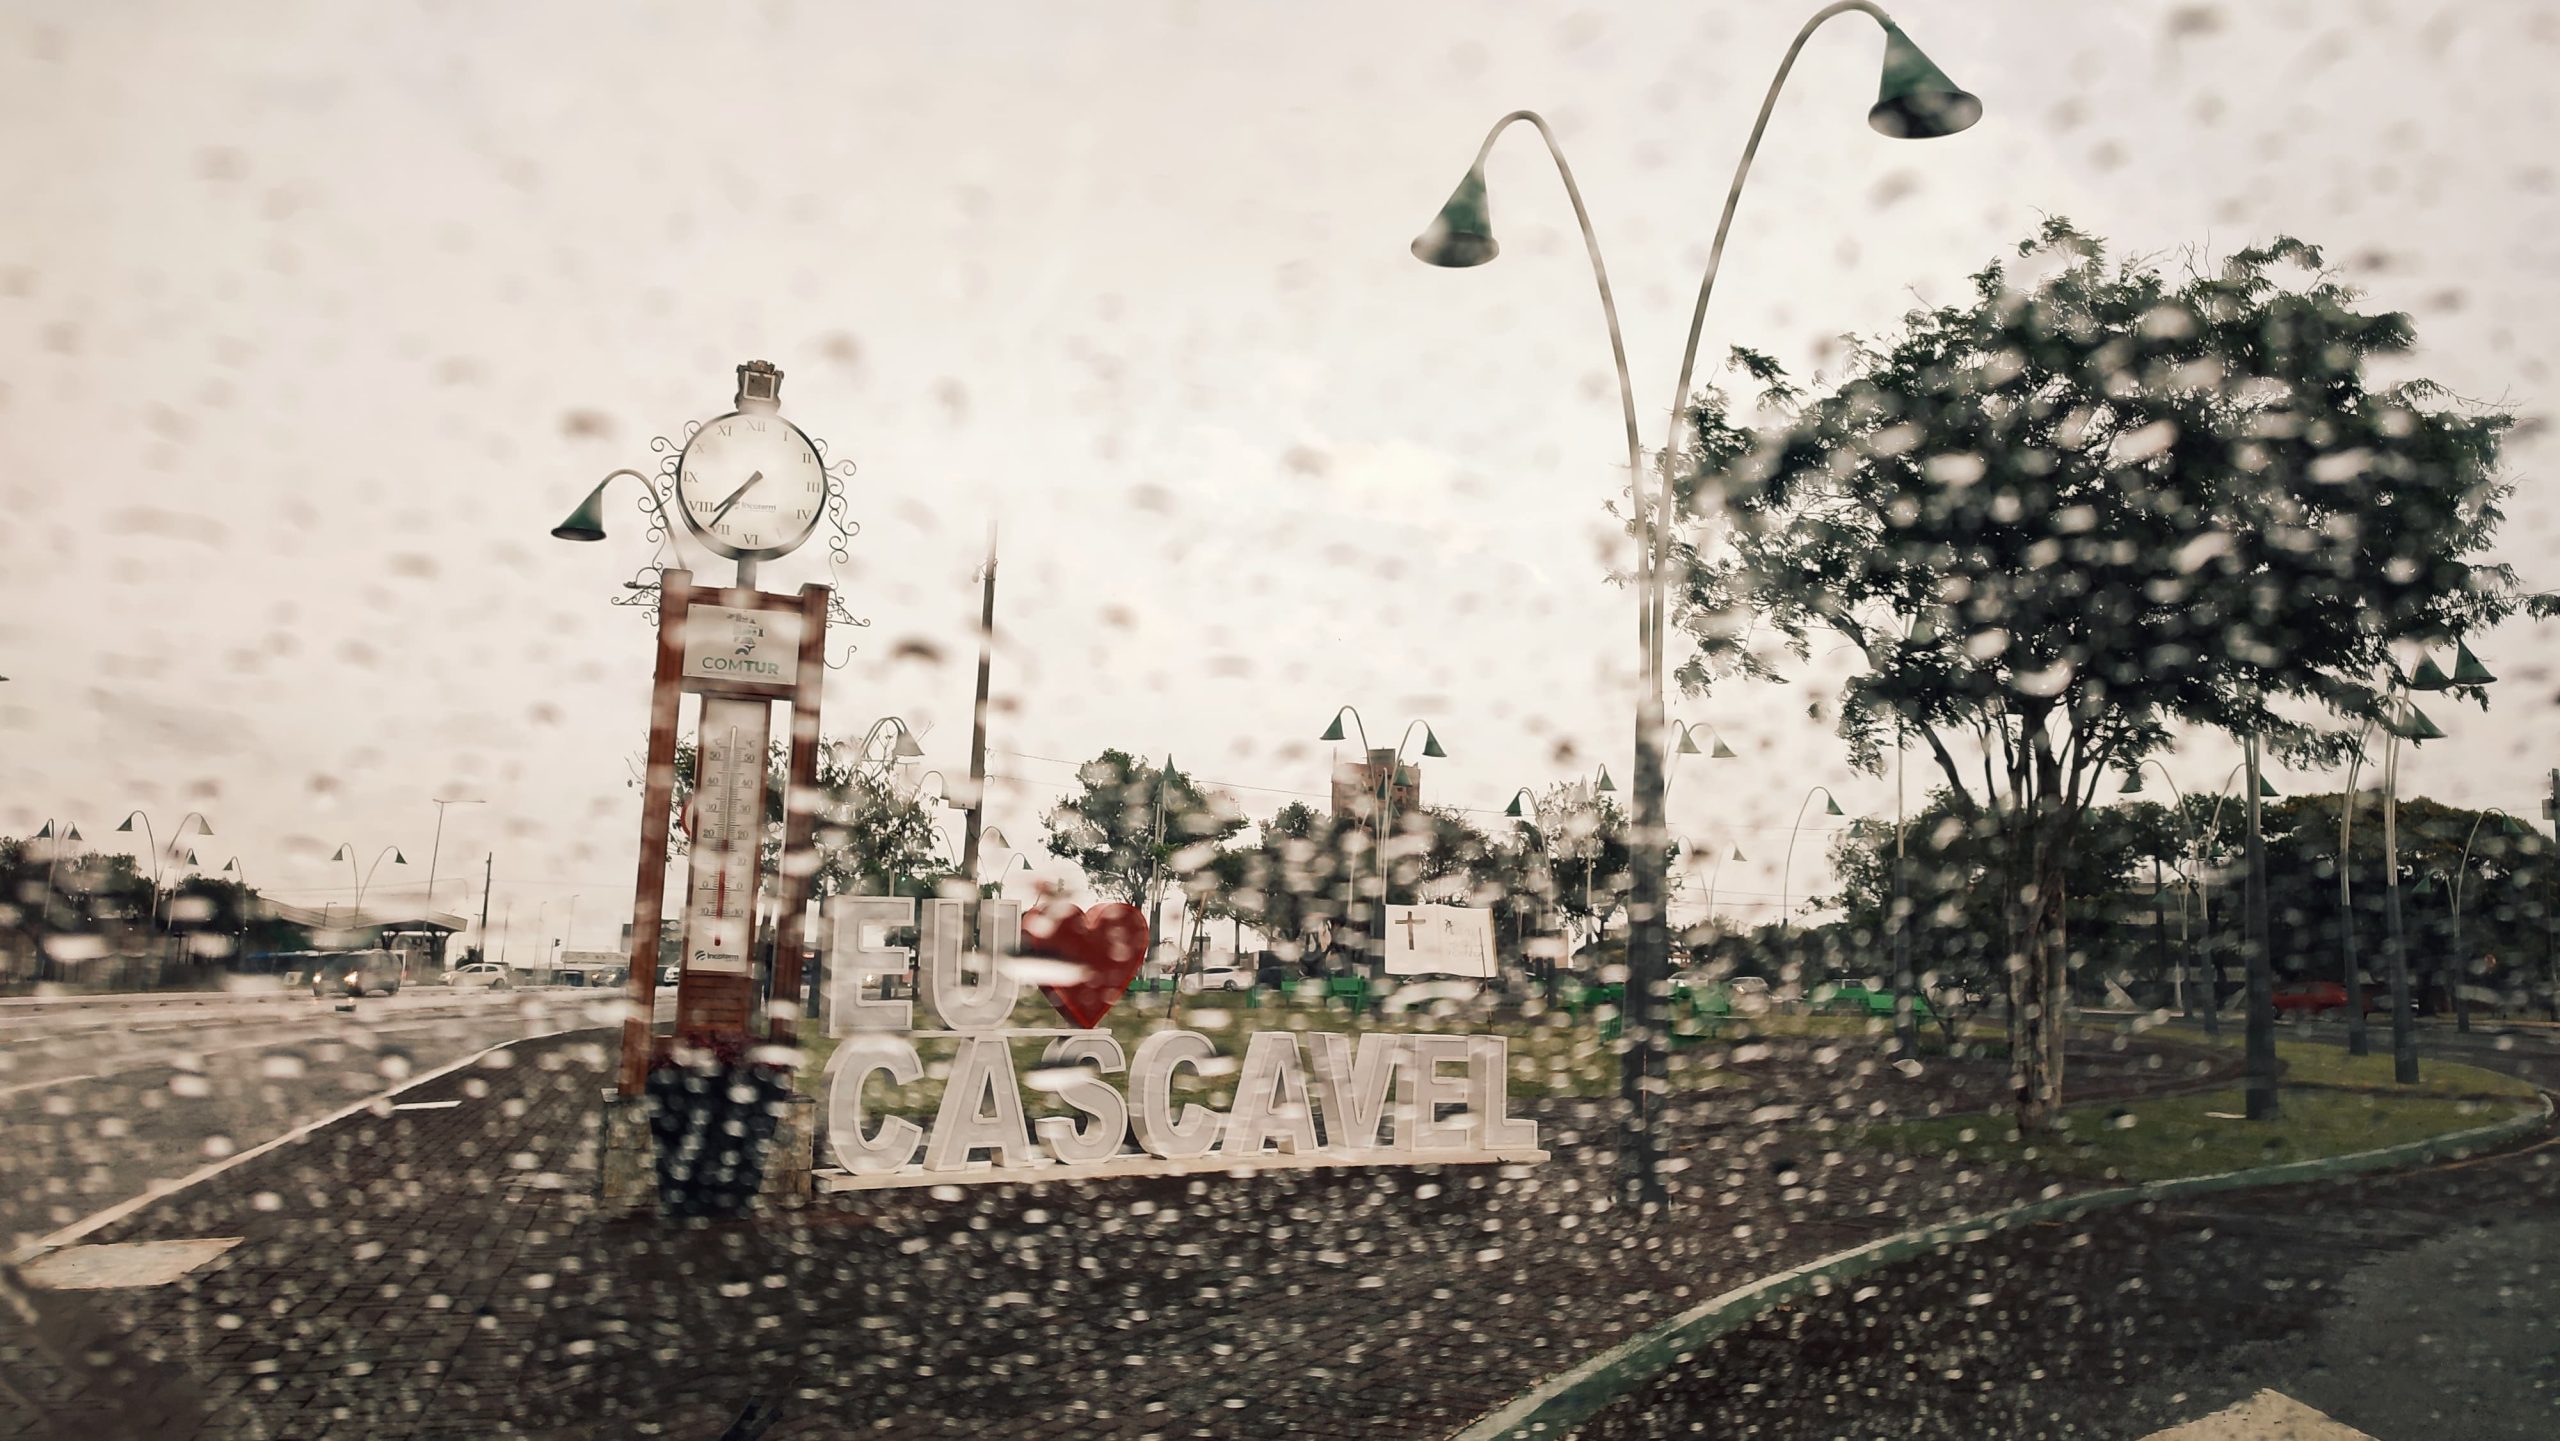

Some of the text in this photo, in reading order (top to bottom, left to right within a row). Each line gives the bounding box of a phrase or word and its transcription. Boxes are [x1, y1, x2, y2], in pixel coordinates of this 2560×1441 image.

[717, 425, 732, 437] XI
[783, 431, 788, 441] I
[802, 452, 811, 463] II
[683, 471, 698, 483] IX
[806, 482, 820, 493] III
[689, 501, 714, 513] VIII
[796, 509, 811, 520] IV
[743, 534, 758, 545] VI
[702, 657, 780, 675] COMTUR
[822, 896, 1023, 1037] EU
[825, 1030, 1540, 1176] CASCAVEL
